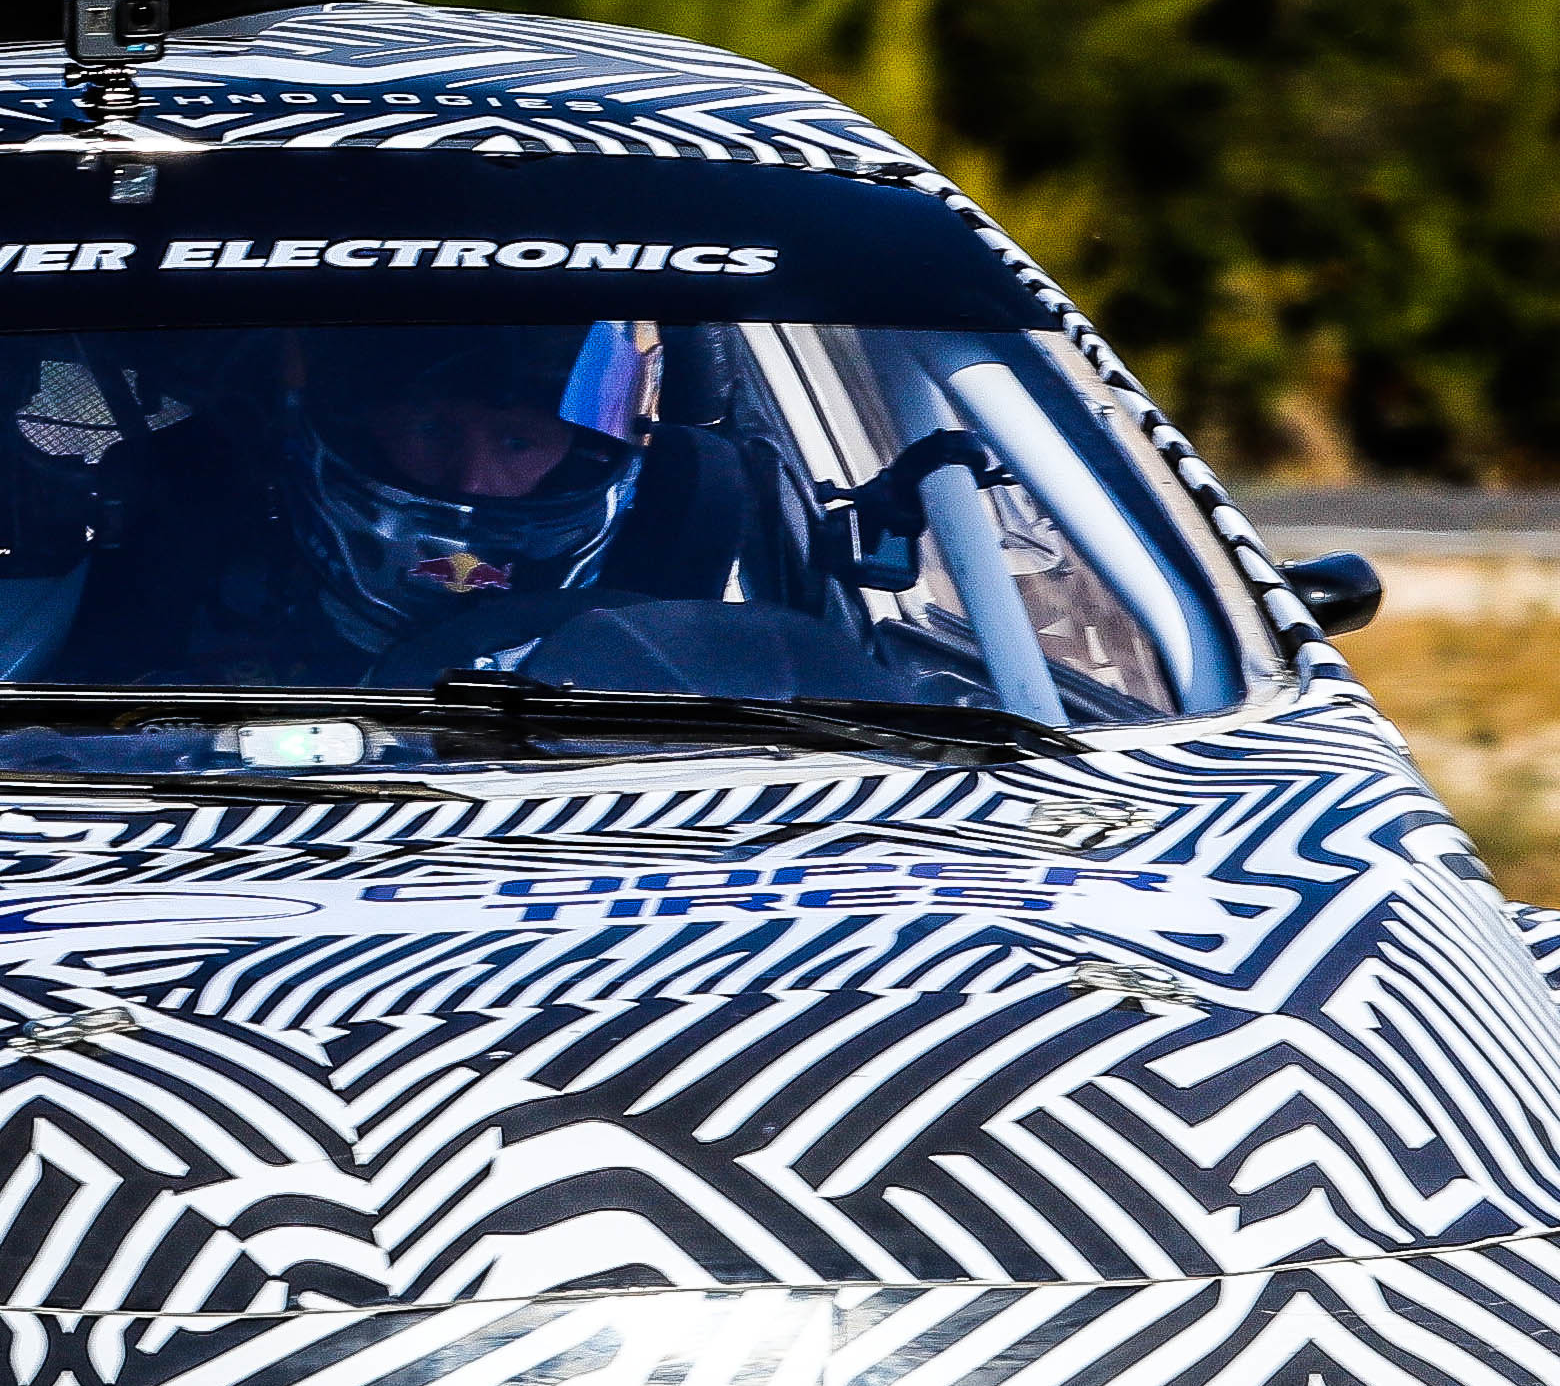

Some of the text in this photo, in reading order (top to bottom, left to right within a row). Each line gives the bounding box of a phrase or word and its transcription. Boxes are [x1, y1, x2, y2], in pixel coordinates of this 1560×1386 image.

[157, 238, 780, 274] ELECTRONICS
[359, 862, 1172, 903] COOPER
[481, 885, 1057, 922] TIRES
